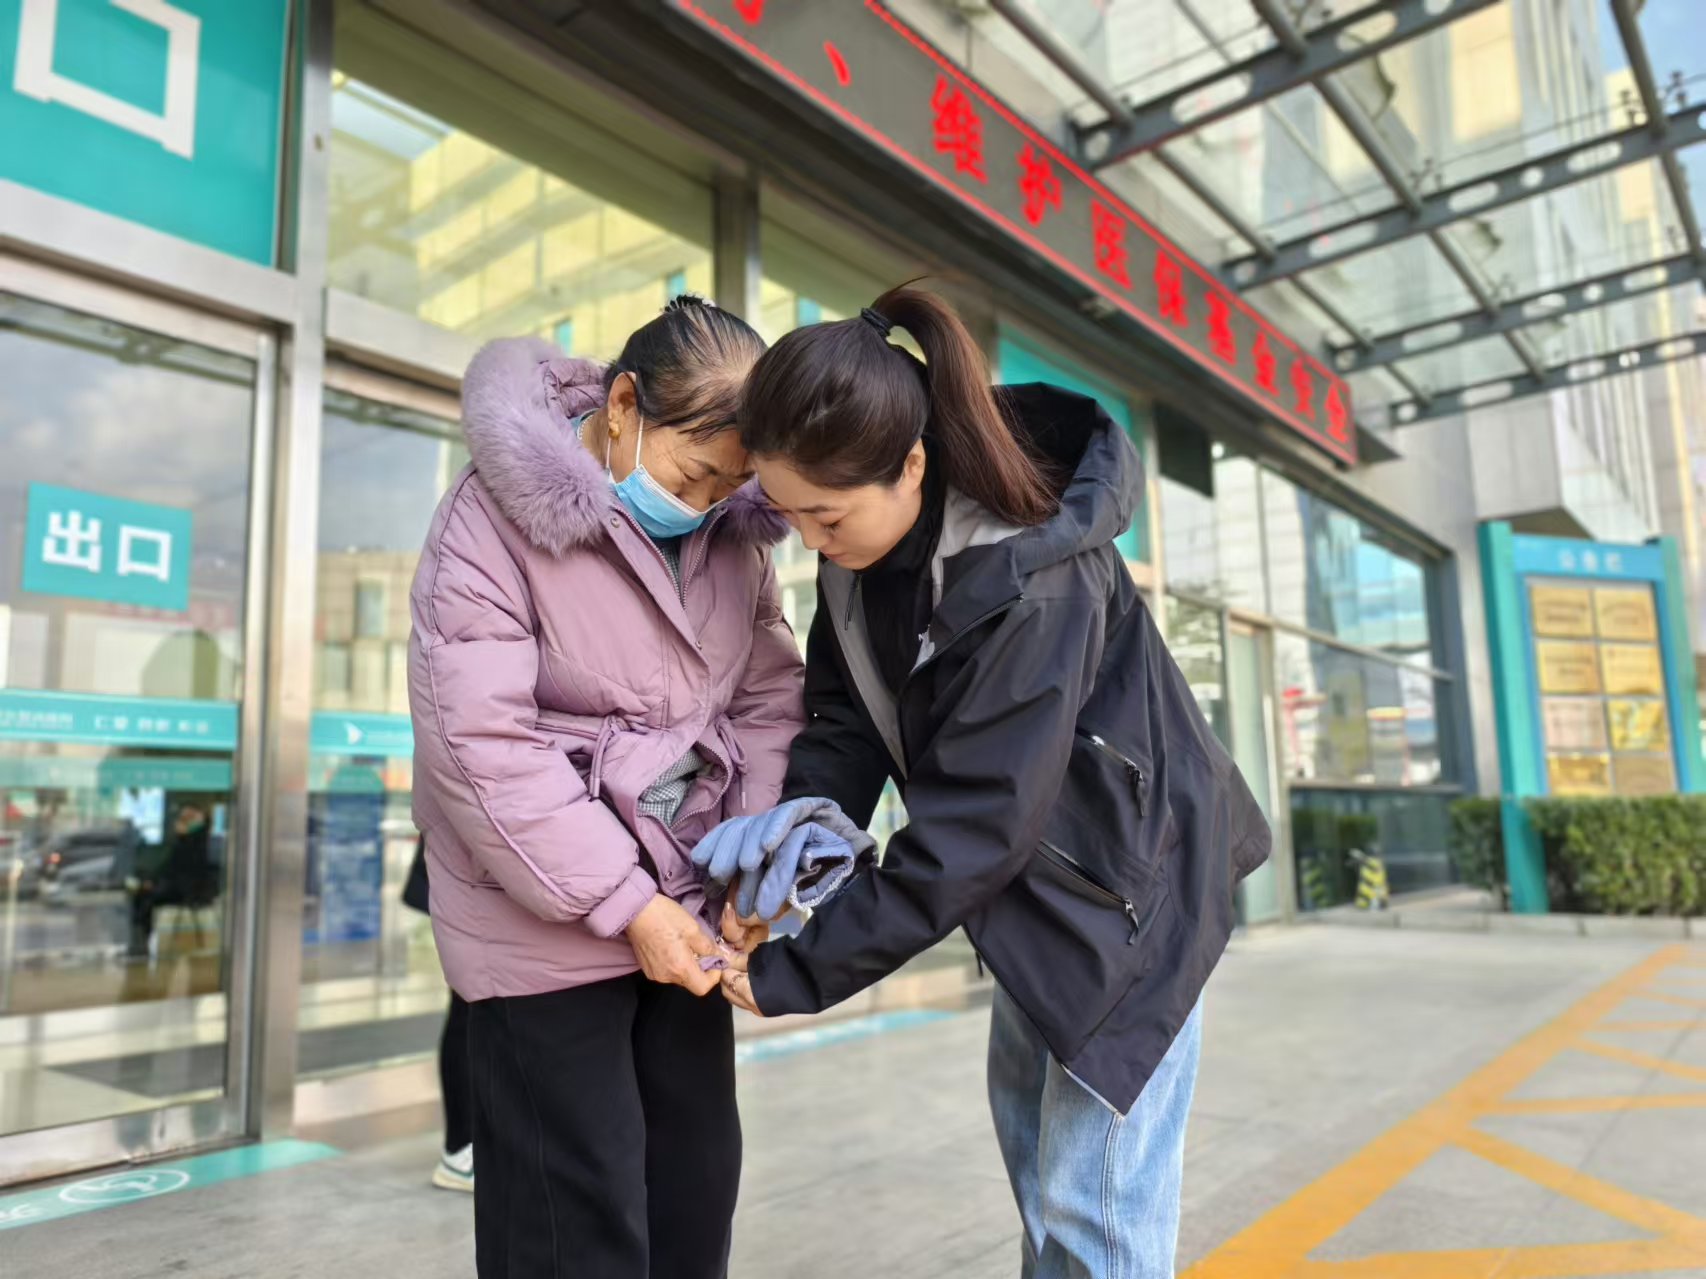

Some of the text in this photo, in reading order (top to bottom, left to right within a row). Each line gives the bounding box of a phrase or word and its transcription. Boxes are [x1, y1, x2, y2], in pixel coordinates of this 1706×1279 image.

[12, 0, 201, 160] 口
[733, 0, 1350, 444] 、维护医保基金安全
[42, 510, 172, 583] 出口
